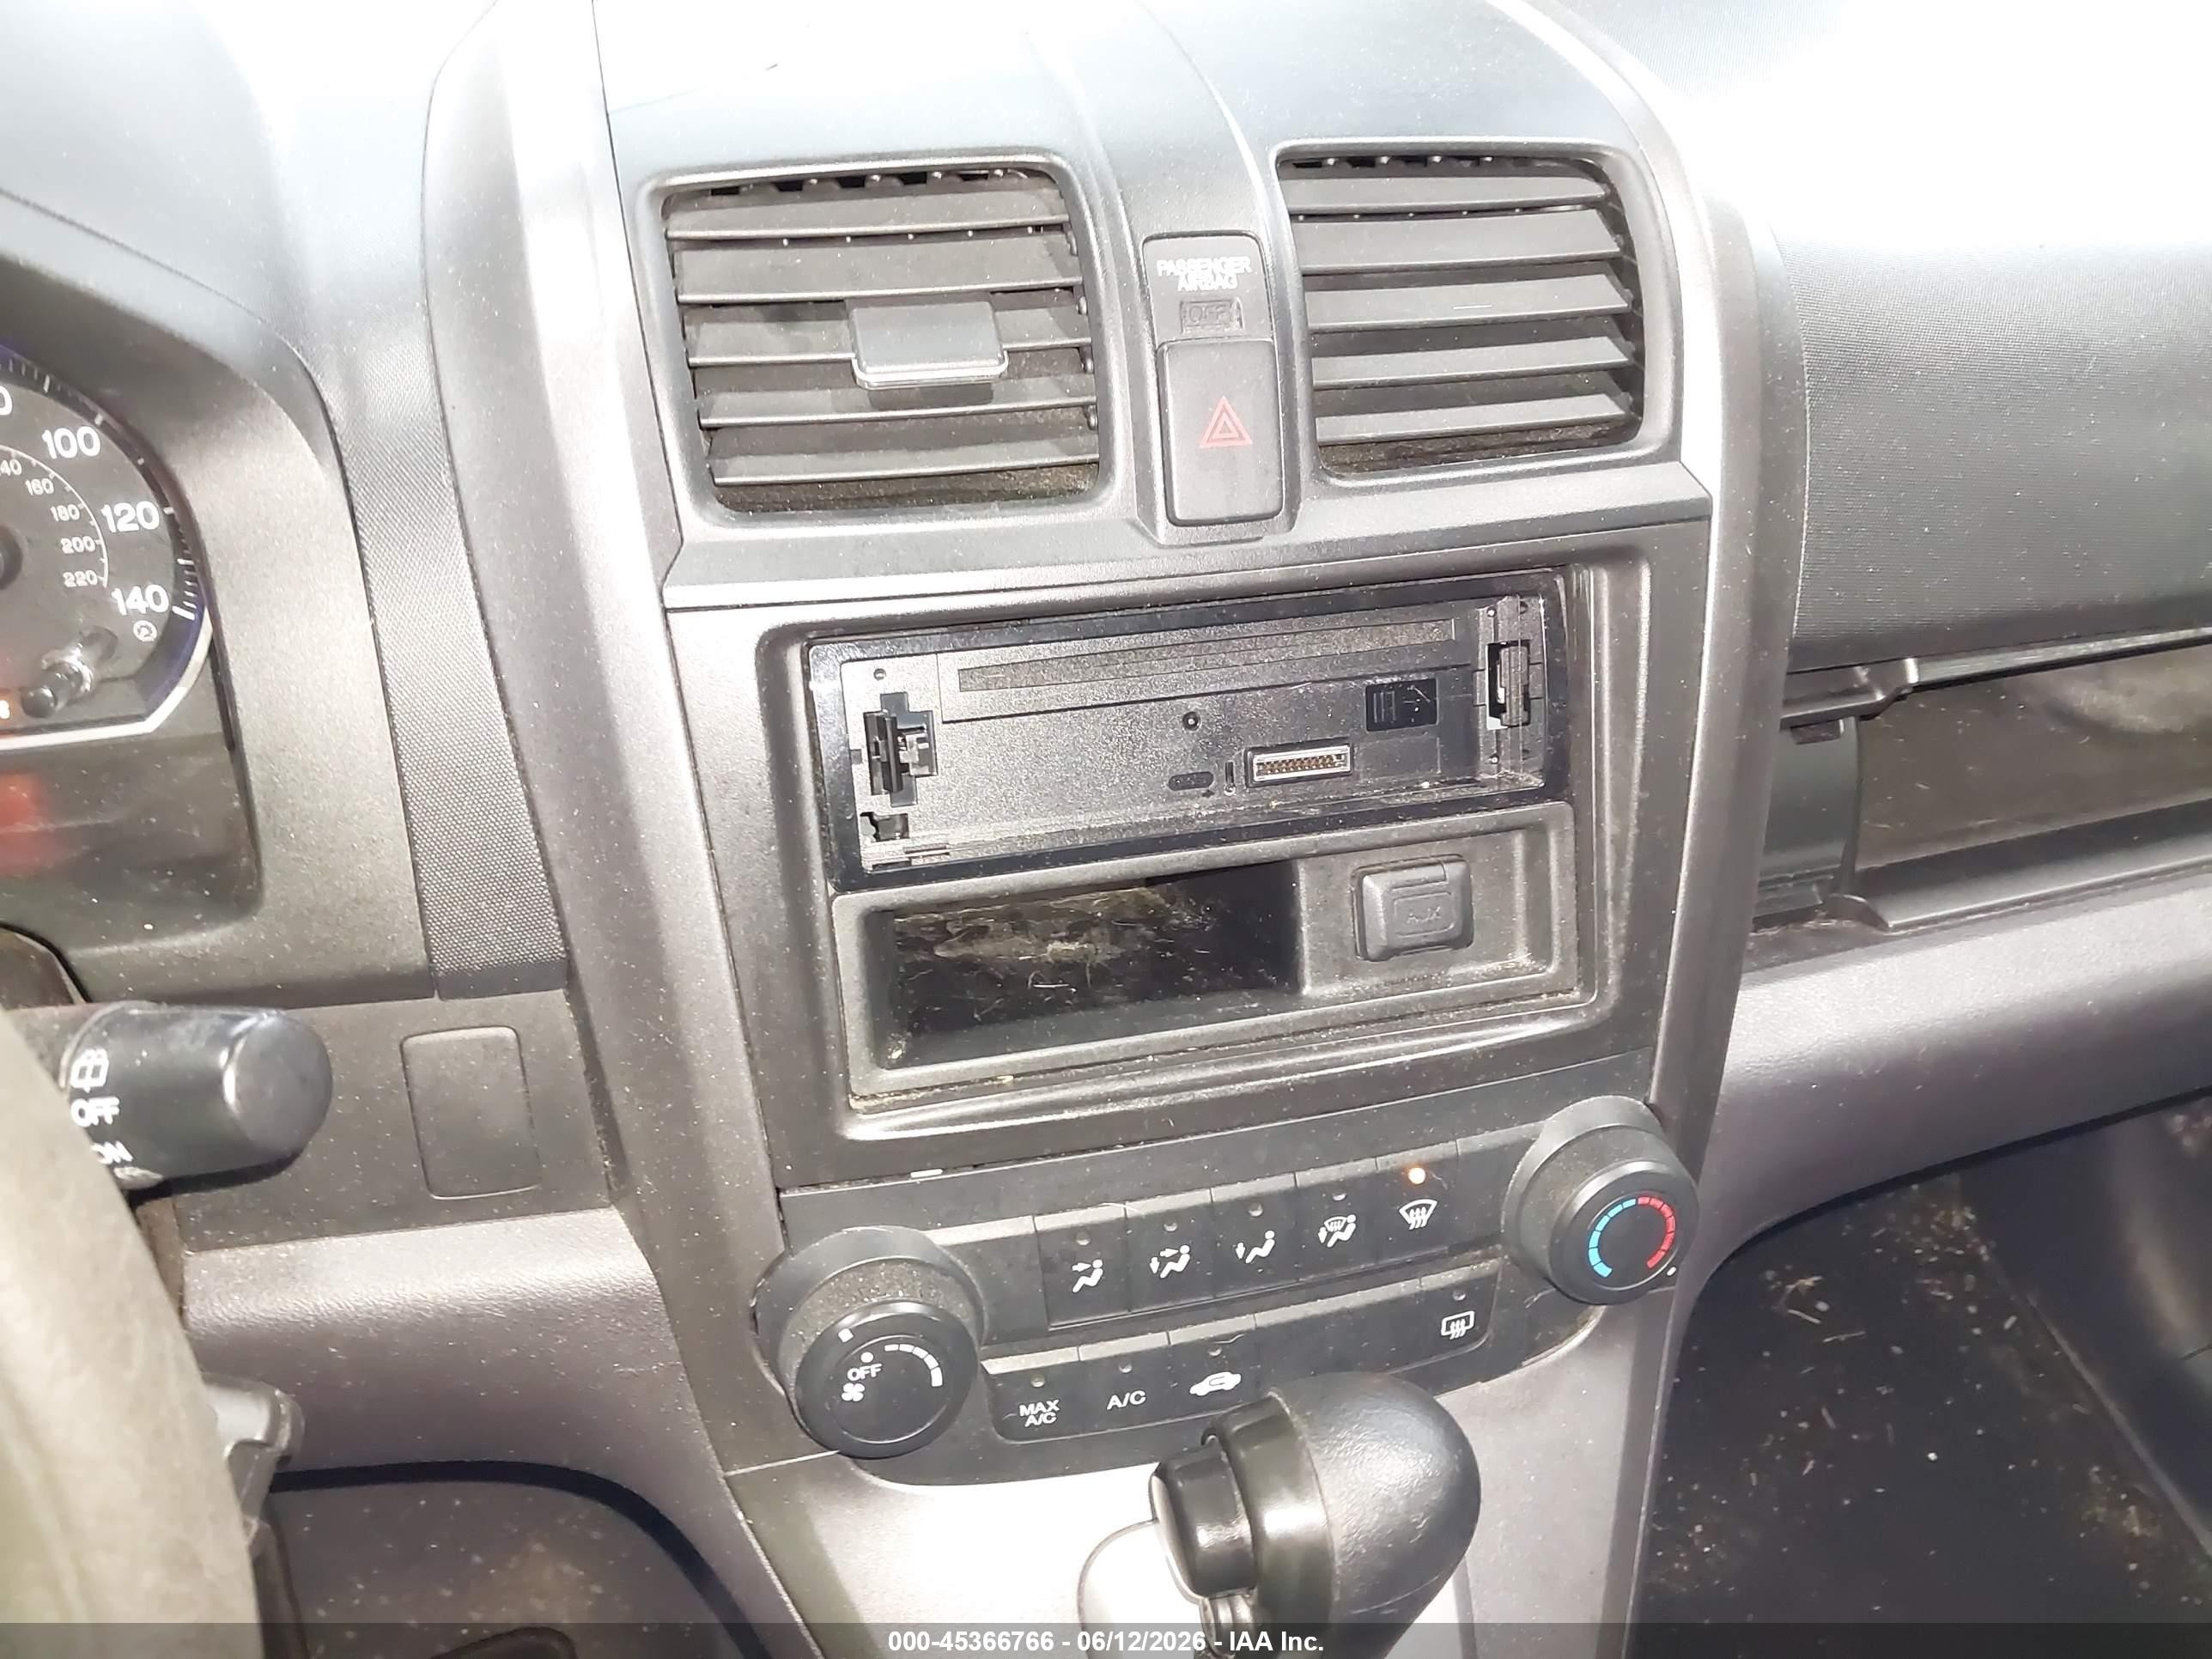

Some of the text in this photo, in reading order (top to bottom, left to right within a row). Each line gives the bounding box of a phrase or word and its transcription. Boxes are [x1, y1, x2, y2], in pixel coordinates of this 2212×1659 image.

[1157, 257, 1252, 276] PASSENGER
[1177, 273, 1237, 291] AIRBAG
[42, 426, 101, 459] 100
[25, 477, 55, 495] 160
[50, 503, 81, 522] 180
[100, 501, 160, 533] 120
[60, 535, 96, 554] 200
[63, 569, 98, 587] 220
[111, 584, 169, 616] 140
[70, 1096, 120, 1127] OFF
[847, 1363, 883, 1382] OFF
[1018, 1399, 1060, 1417] MAX
[1106, 1389, 1146, 1410] A/C
[1024, 1411, 1058, 1427] A/C
